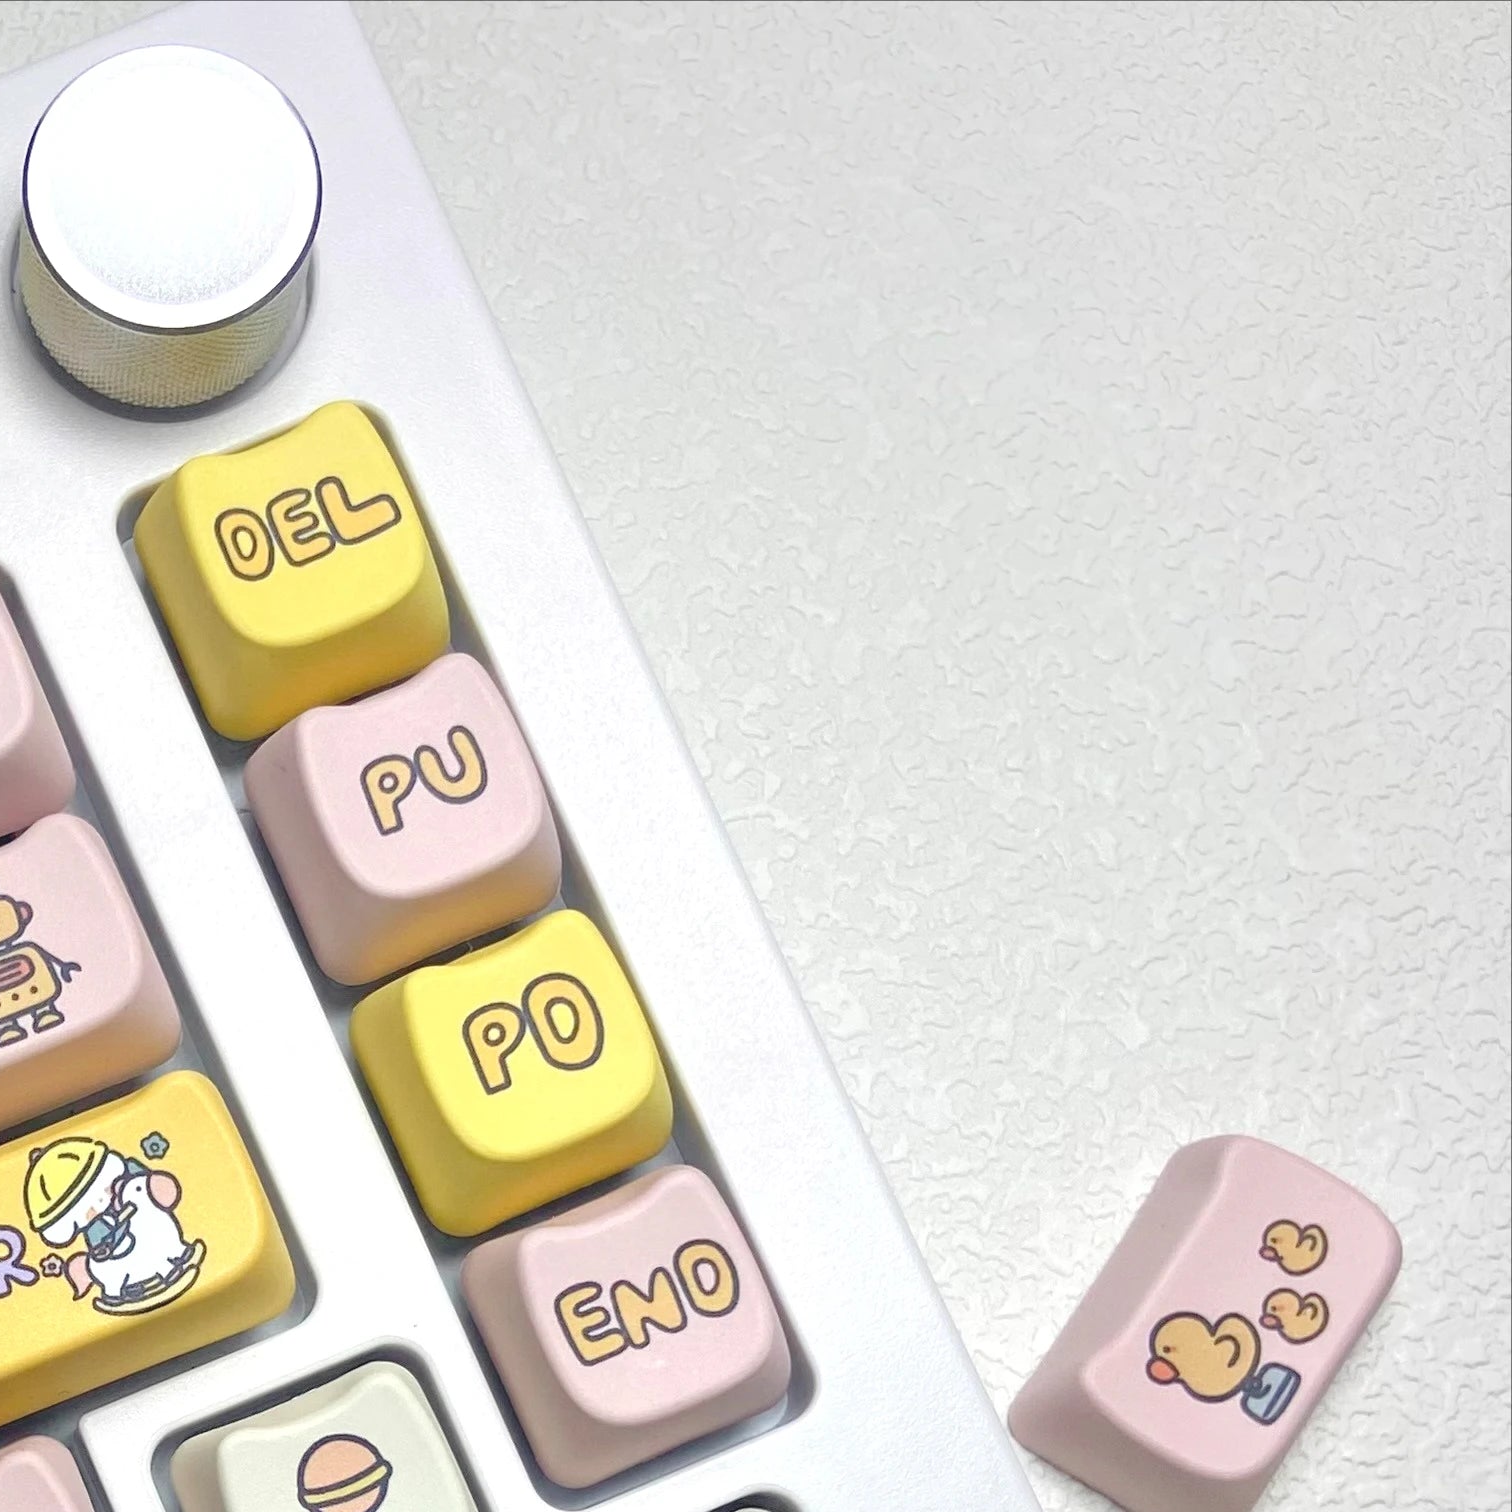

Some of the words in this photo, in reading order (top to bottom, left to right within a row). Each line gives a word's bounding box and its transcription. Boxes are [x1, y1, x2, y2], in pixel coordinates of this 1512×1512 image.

[212, 474, 402, 583] DEL
[359, 724, 489, 836] PU
[553, 1238, 742, 1368] END
